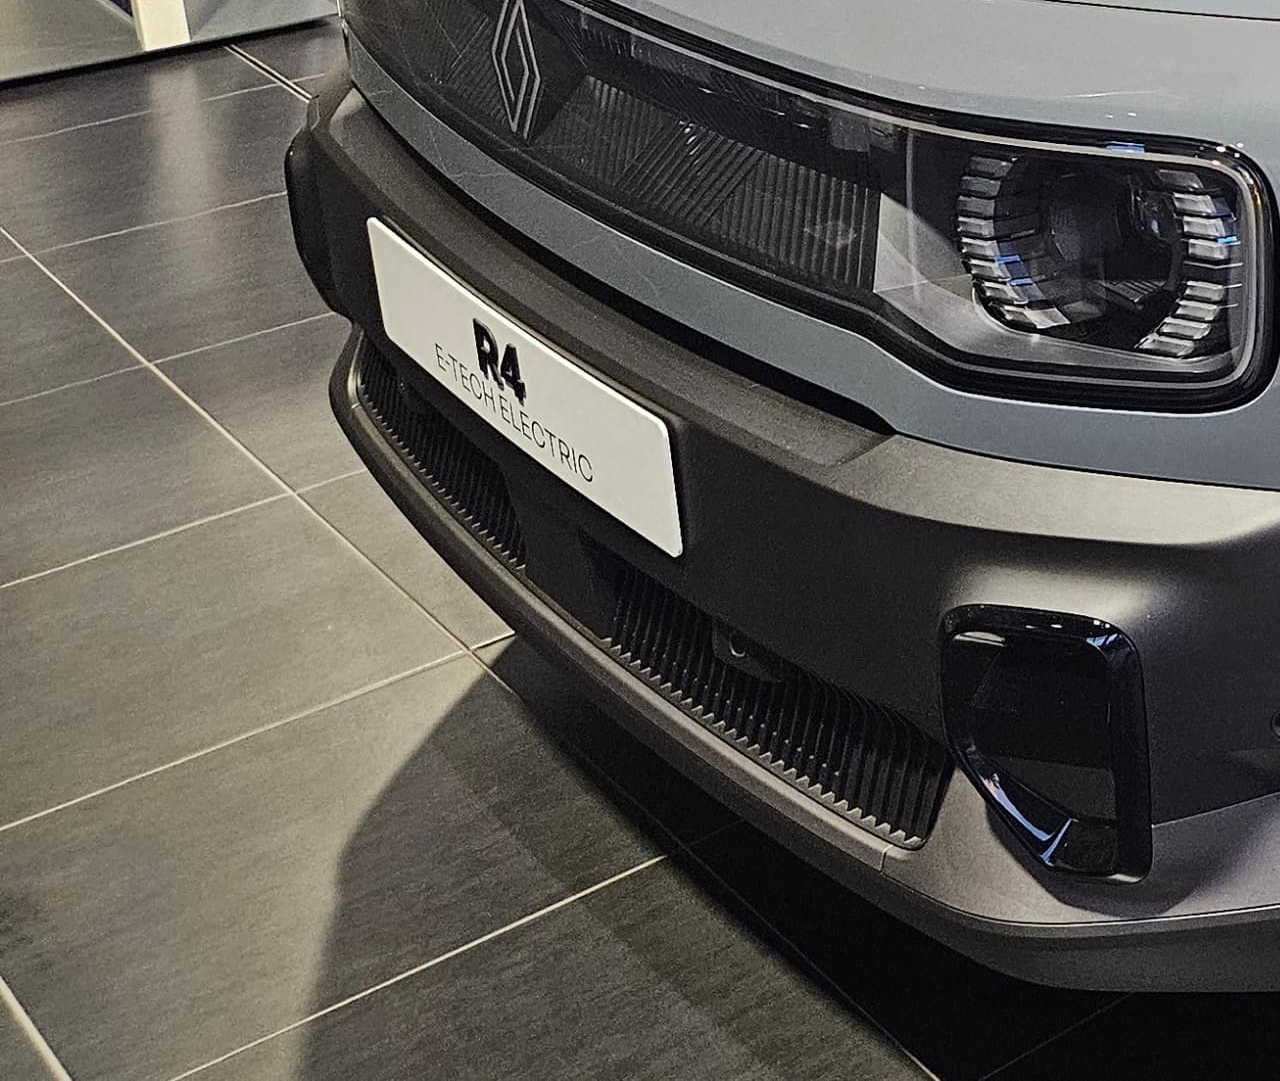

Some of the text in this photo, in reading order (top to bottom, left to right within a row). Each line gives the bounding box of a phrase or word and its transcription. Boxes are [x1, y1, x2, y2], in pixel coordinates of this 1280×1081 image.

[434, 343, 594, 483] E-TECH ELECTRIC
[472, 318, 527, 407] R4
